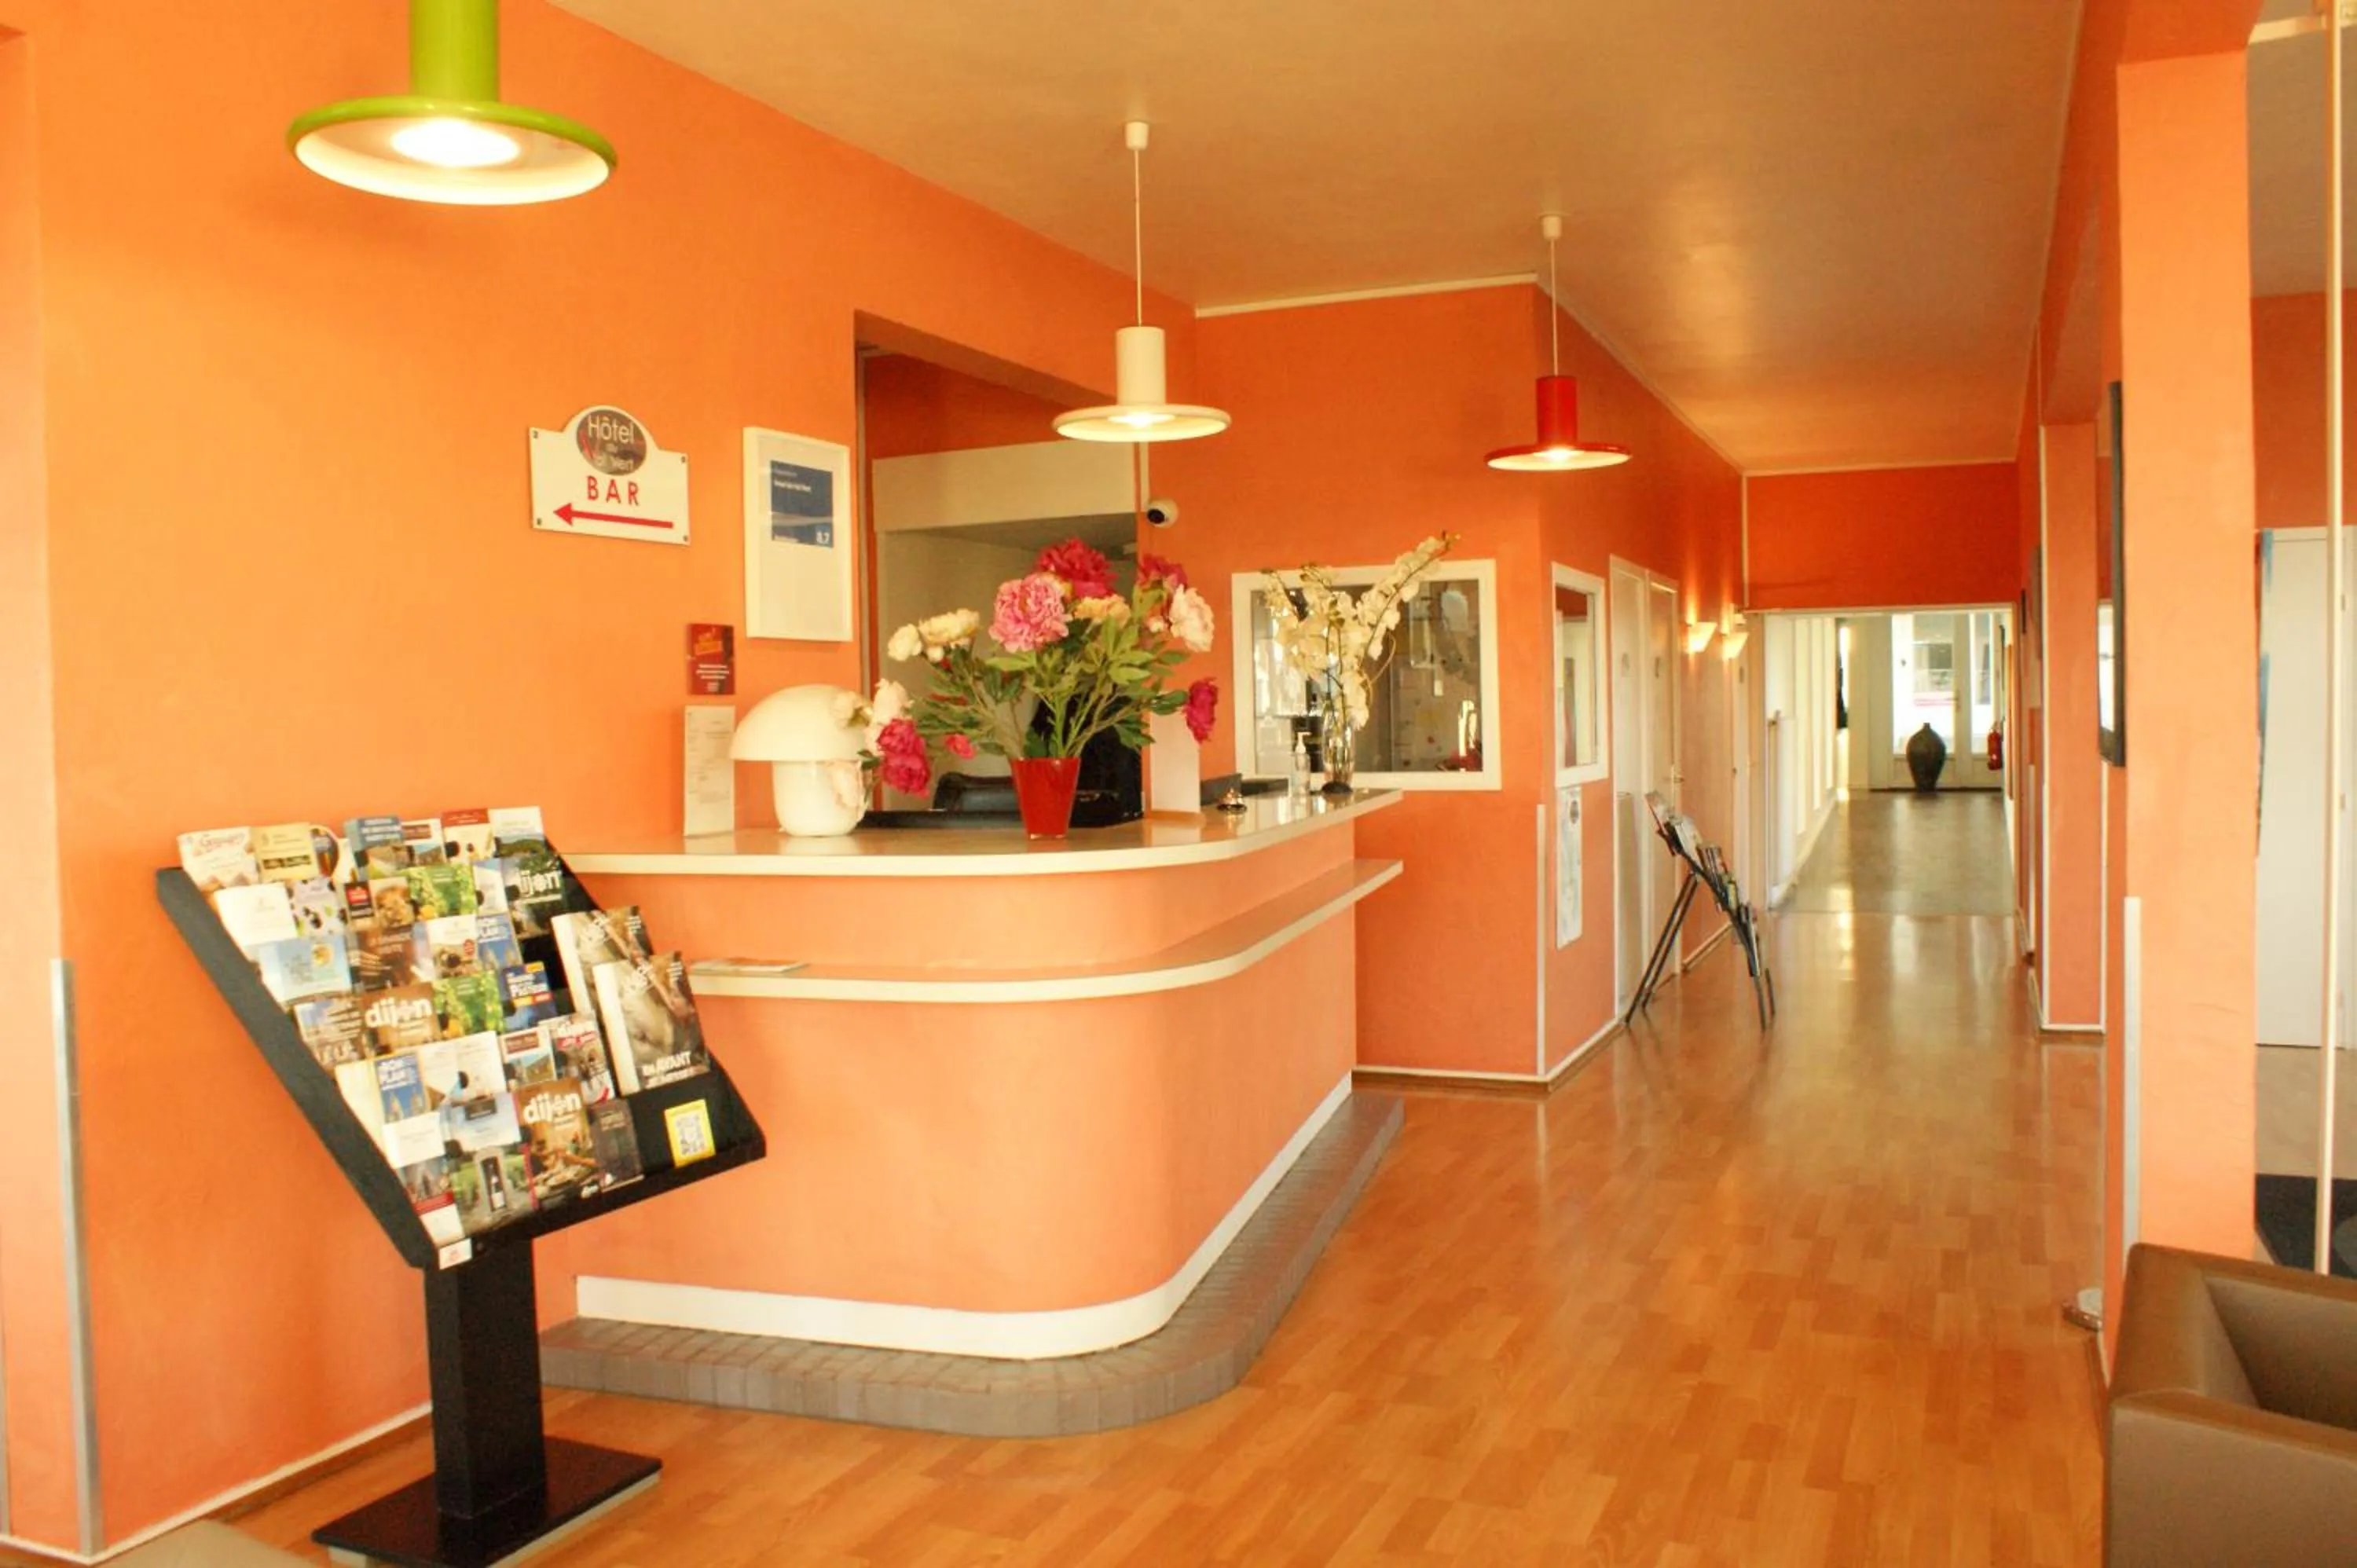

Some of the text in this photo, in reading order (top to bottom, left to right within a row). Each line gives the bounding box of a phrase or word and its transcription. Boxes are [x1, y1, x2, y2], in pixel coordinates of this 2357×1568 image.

[587, 414, 635, 445] Hôtel
[587, 474, 640, 506] BAR
[365, 997, 432, 1028] dijon
[523, 1092, 582, 1124] dijon
